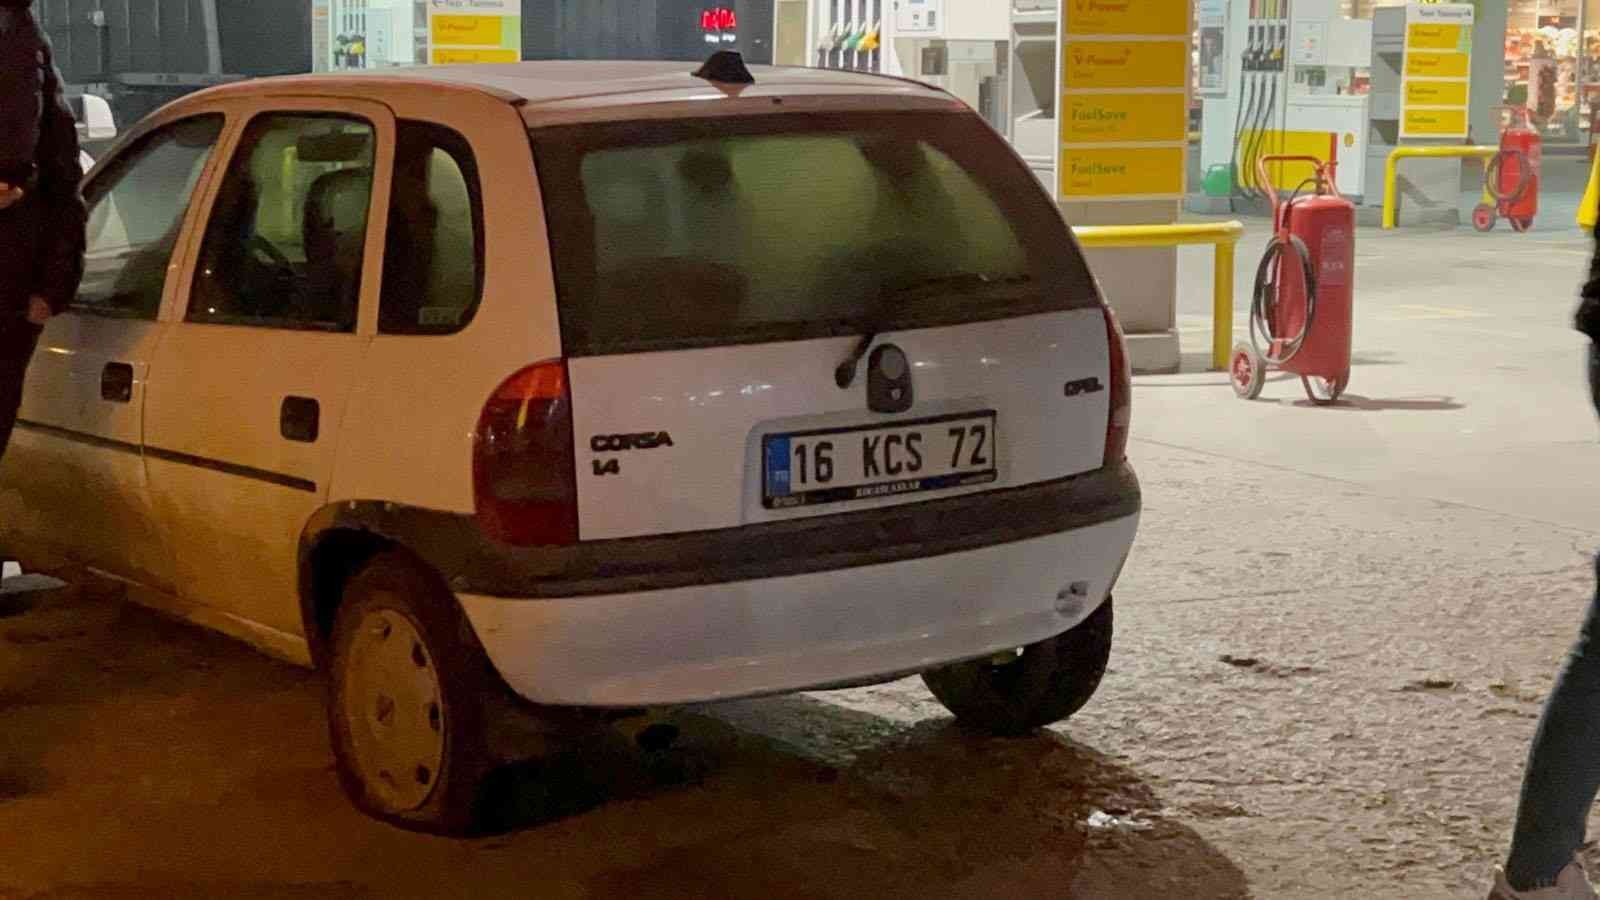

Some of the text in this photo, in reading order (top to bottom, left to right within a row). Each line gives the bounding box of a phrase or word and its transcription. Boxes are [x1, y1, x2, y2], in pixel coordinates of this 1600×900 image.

[590, 430, 674, 452] CORSA
[795, 424, 987, 484] 16 KCS 72
